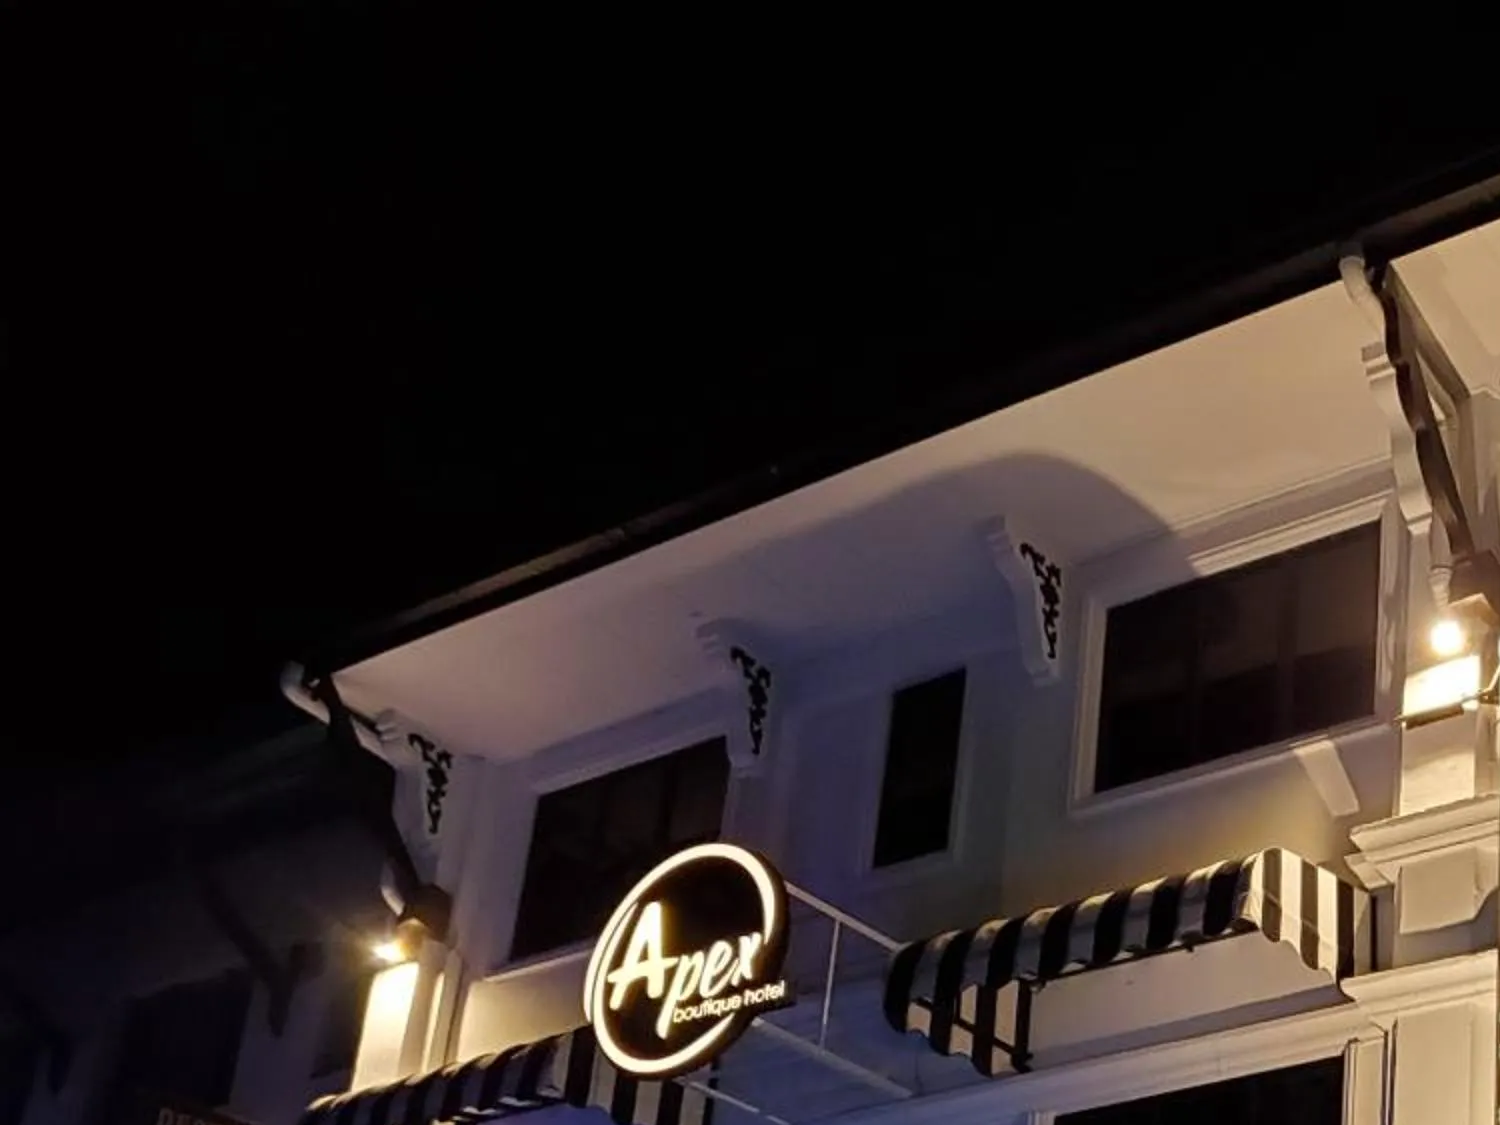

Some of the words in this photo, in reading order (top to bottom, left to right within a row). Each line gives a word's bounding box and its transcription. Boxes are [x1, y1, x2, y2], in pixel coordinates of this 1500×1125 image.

[607, 900, 763, 1040] Apex
[672, 993, 743, 1024] boutique
[744, 980, 786, 1005] hotel
